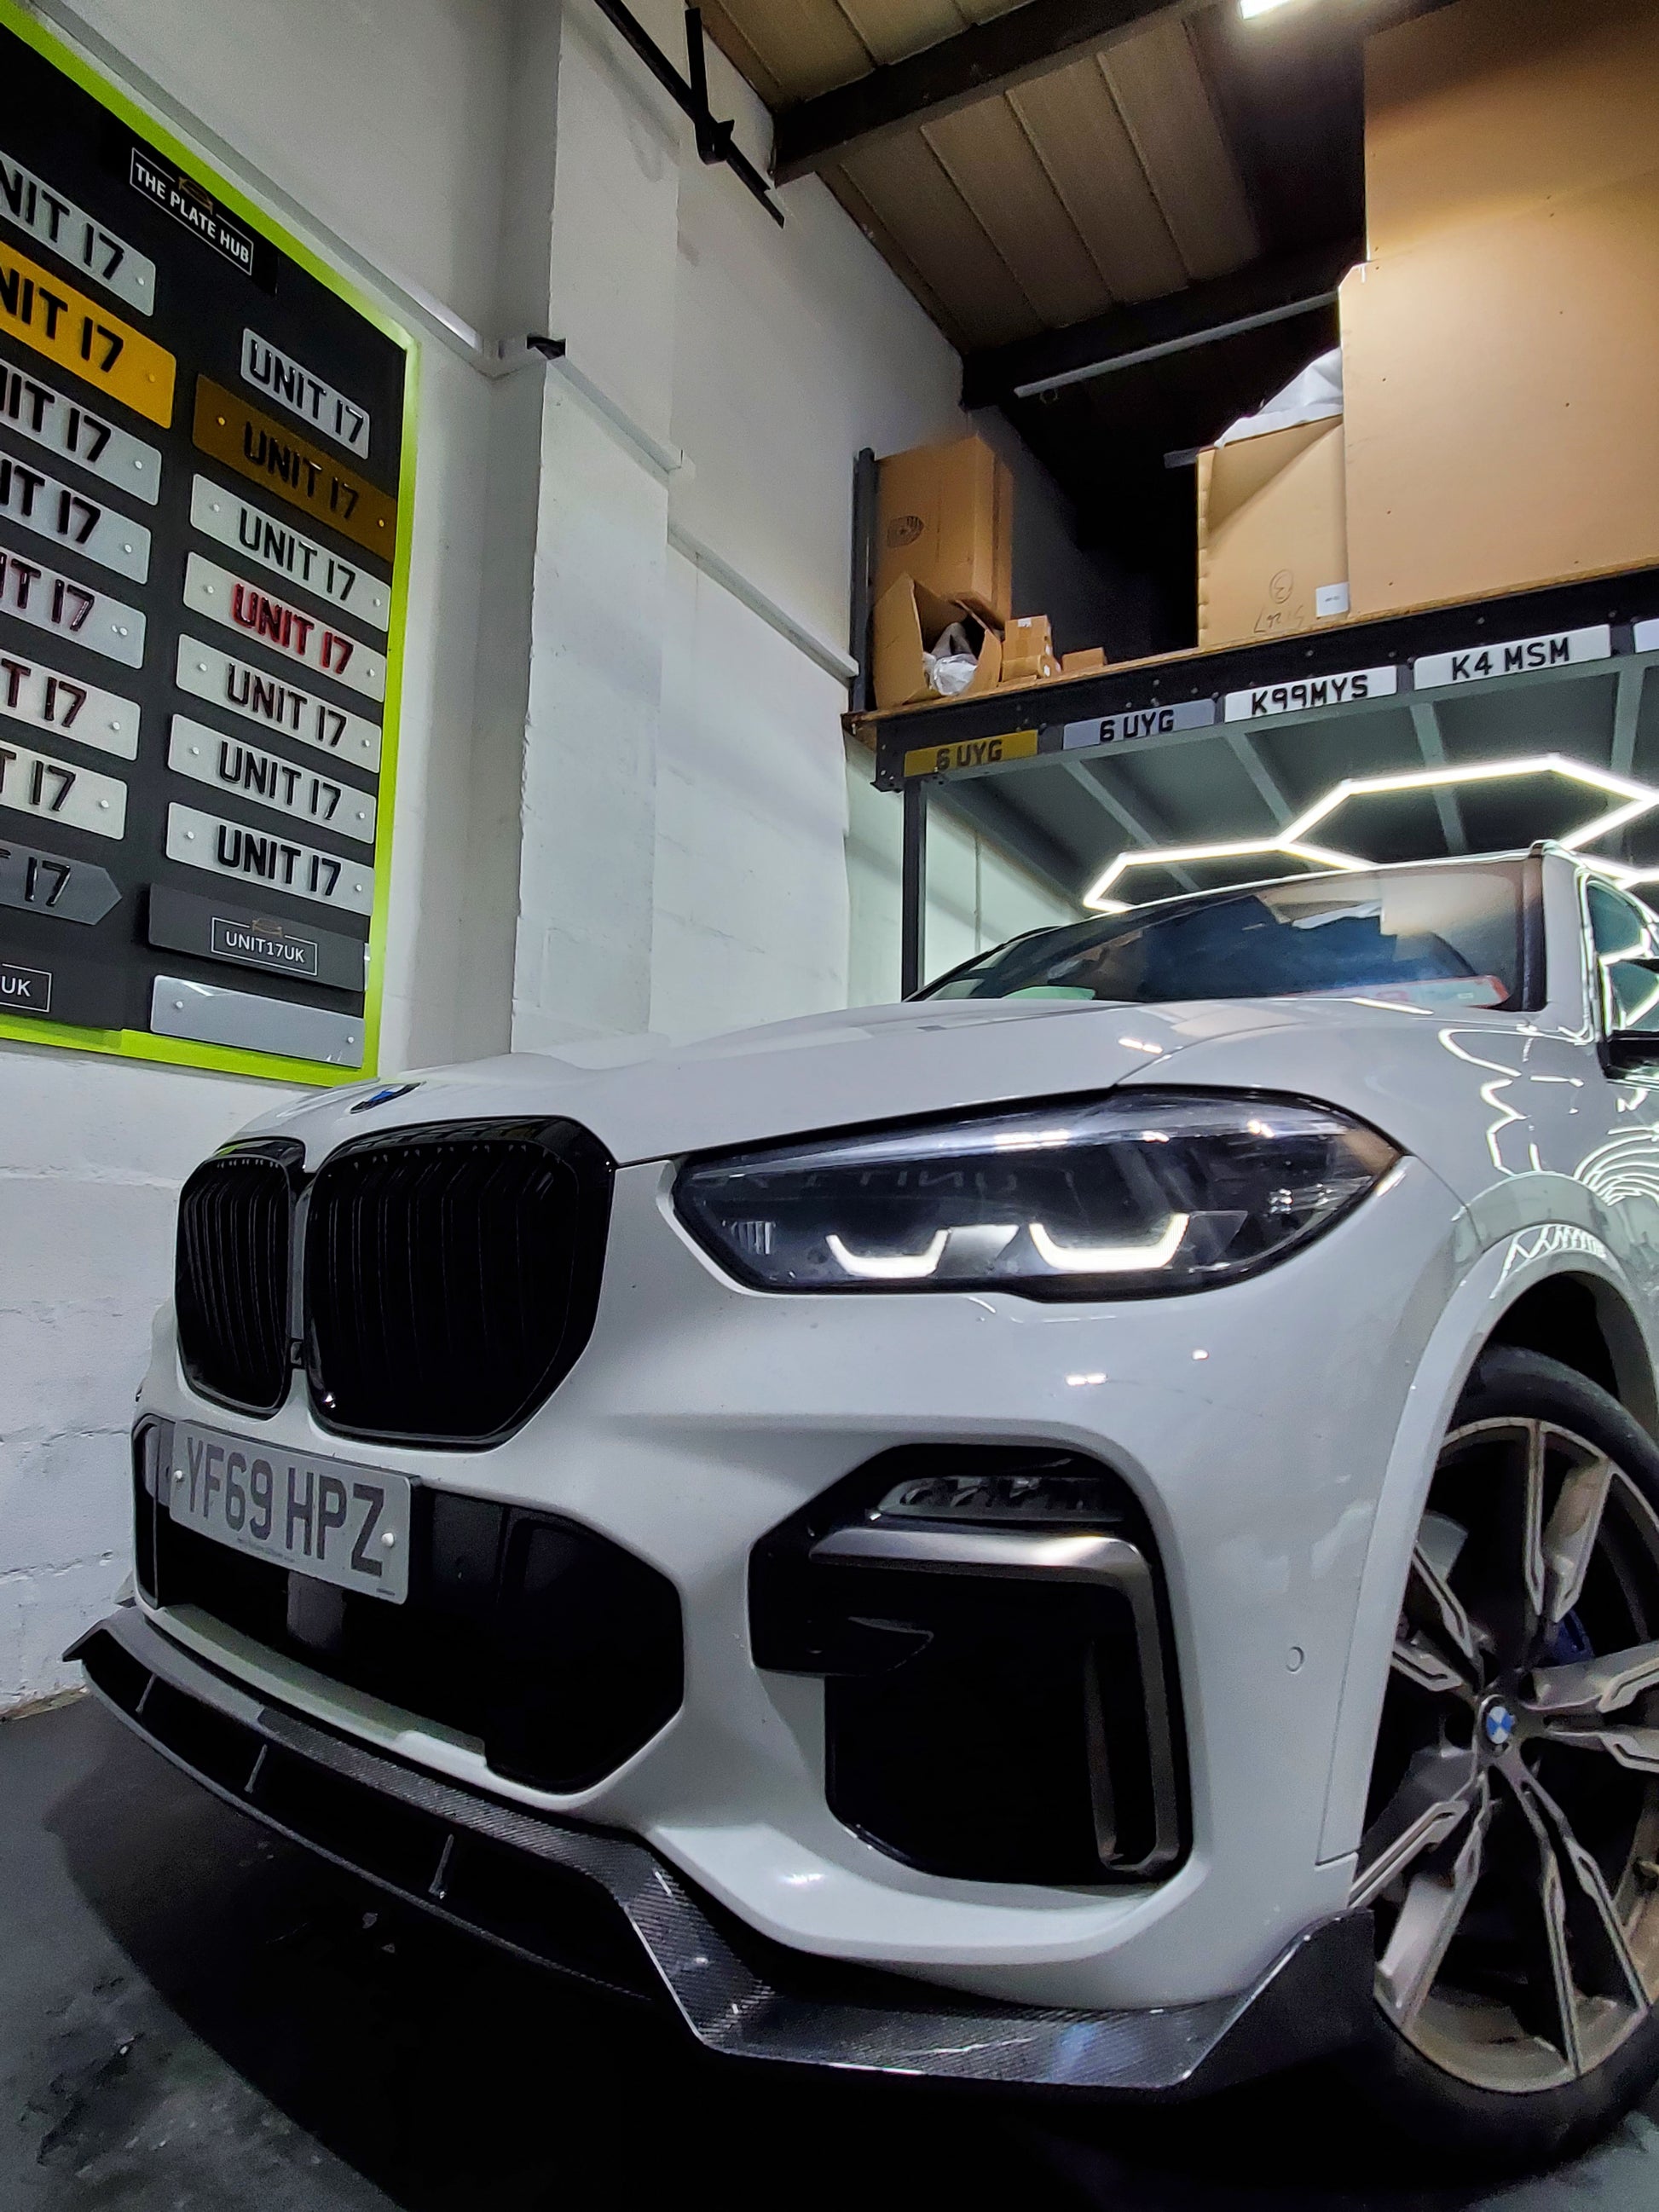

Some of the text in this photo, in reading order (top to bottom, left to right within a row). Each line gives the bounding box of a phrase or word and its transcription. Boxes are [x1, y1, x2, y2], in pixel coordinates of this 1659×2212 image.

[135, 162, 249, 263] THE PLATE HUB
[84, 222, 124, 280] 17
[81, 316, 124, 373] 17
[250, 339, 364, 443] UNIT 17
[67, 407, 111, 462] 17
[244, 421, 359, 519] UNIT 17
[58, 490, 101, 544] 17
[240, 507, 356, 601] UNIT 17
[51, 579, 95, 632] 17
[231, 583, 354, 674] UNIT 17
[1452, 637, 1569, 680] K4 MSM
[44, 676, 87, 728] 17
[228, 662, 347, 748] UNIT 17
[1251, 674, 1368, 715] K99MYS
[957, 740, 1003, 767] UYG
[1100, 709, 1174, 742] 6 UYG
[30, 760, 76, 811] 17
[219, 741, 342, 820] UNIT 17
[25, 857, 70, 906] 17
[217, 825, 342, 896] UNIT 17
[226, 931, 305, 963] UNIT17UK
[187, 1437, 384, 1577] YF69 HPZ
